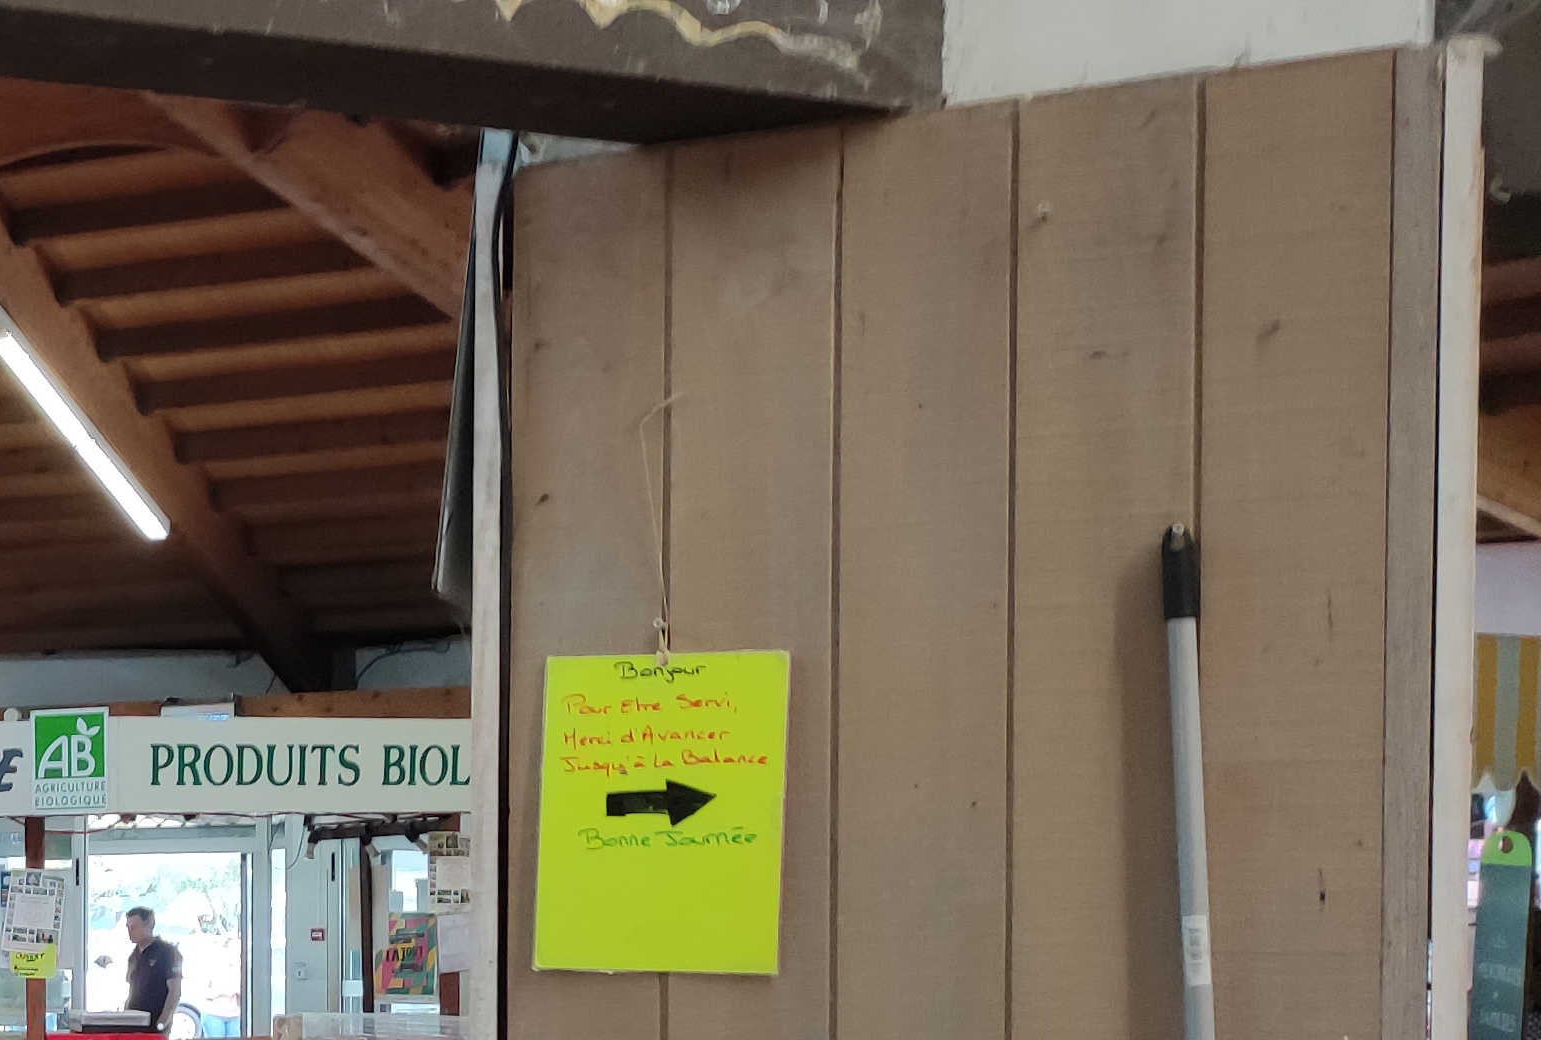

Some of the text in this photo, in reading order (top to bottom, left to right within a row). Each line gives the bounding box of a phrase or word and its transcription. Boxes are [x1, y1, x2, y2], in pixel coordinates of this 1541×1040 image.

[614, 660, 706, 683] Bonjour
[561, 693, 612, 716] Pour
[37, 734, 96, 779] AB
[150, 743, 471, 787] PRODUITS BIOL
[34, 781, 106, 794] AGRICULTURE
[34, 794, 106, 807] BIOLOGIQUE
[578, 827, 651, 850] Bonne
